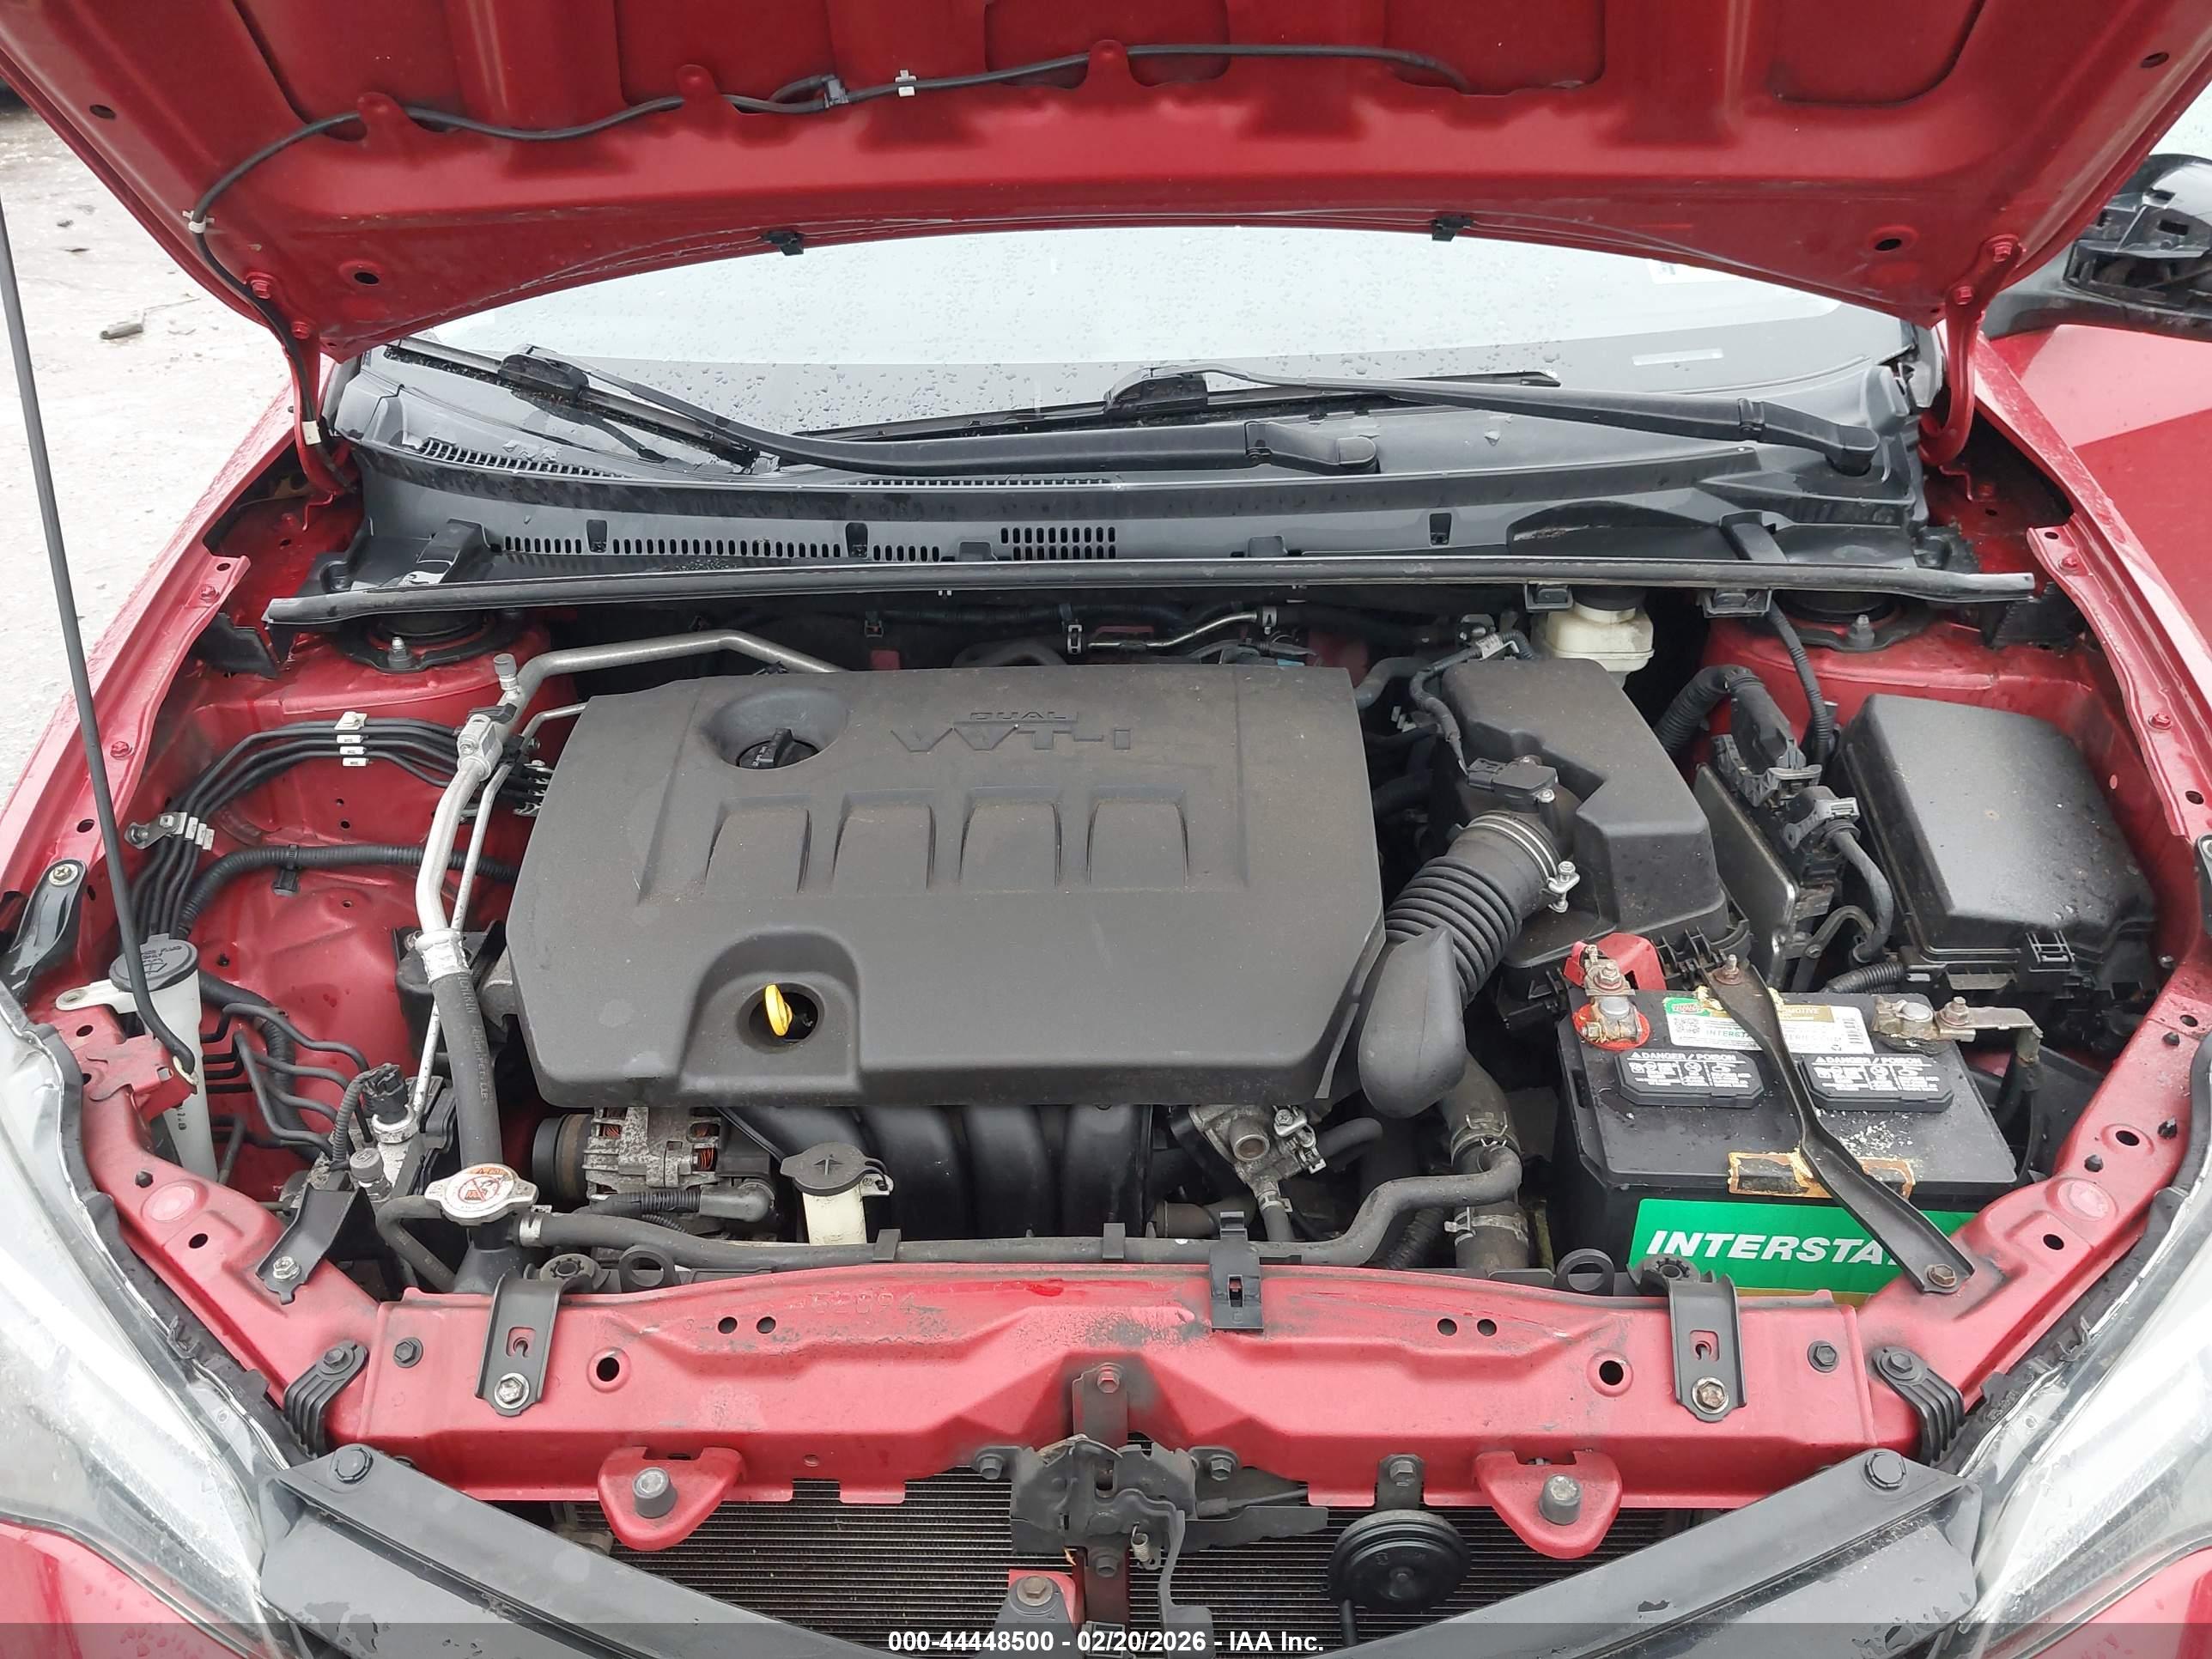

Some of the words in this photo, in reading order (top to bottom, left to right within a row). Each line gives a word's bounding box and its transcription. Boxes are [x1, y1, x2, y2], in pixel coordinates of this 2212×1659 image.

[970, 711, 1066, 720] DUAL
[1706, 1030, 1749, 1038] INTERST
[1696, 1053, 1737, 1061] POISON
[1646, 1231, 1898, 1265] INTERSTA
